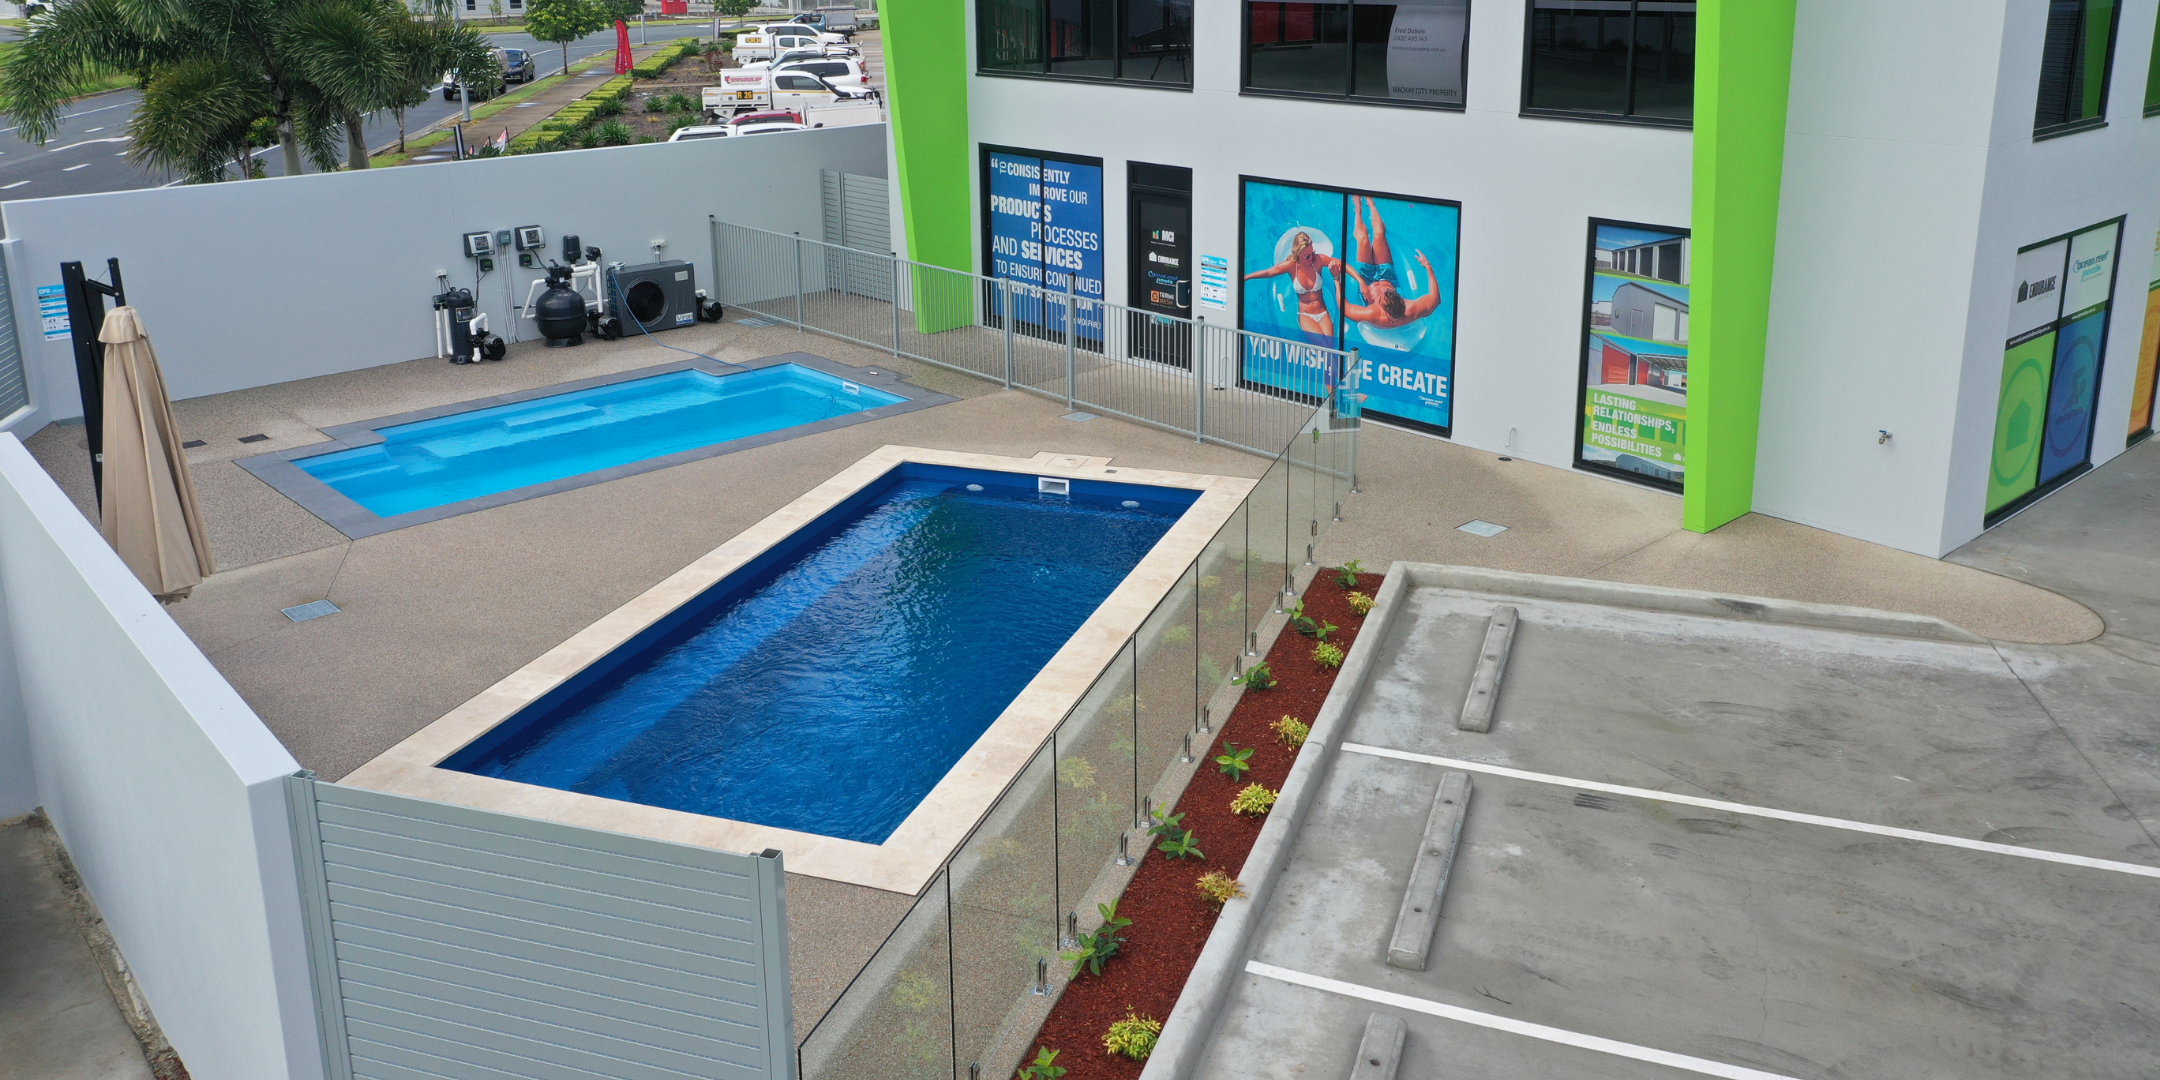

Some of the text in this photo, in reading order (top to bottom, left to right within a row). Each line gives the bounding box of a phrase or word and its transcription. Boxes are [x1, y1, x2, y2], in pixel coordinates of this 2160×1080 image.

[1007, 162, 1071, 184] CONSISENTLY
[1029, 183, 1088, 205] IMROVE OUR
[992, 235, 1018, 256] AND
[1031, 222, 1098, 251] POCESSES
[996, 259, 1008, 274] TO
[1046, 270, 1102, 295] CONNUED
[1249, 336, 1280, 360] YOU
[1378, 364, 1448, 398] CREATE
[1594, 393, 1636, 411] LASTING
[1592, 421, 1637, 439] ENDLESS
[1594, 406, 1675, 434] RELATIONSHIPS,
[1592, 433, 1662, 457] POSSIBILITIES
